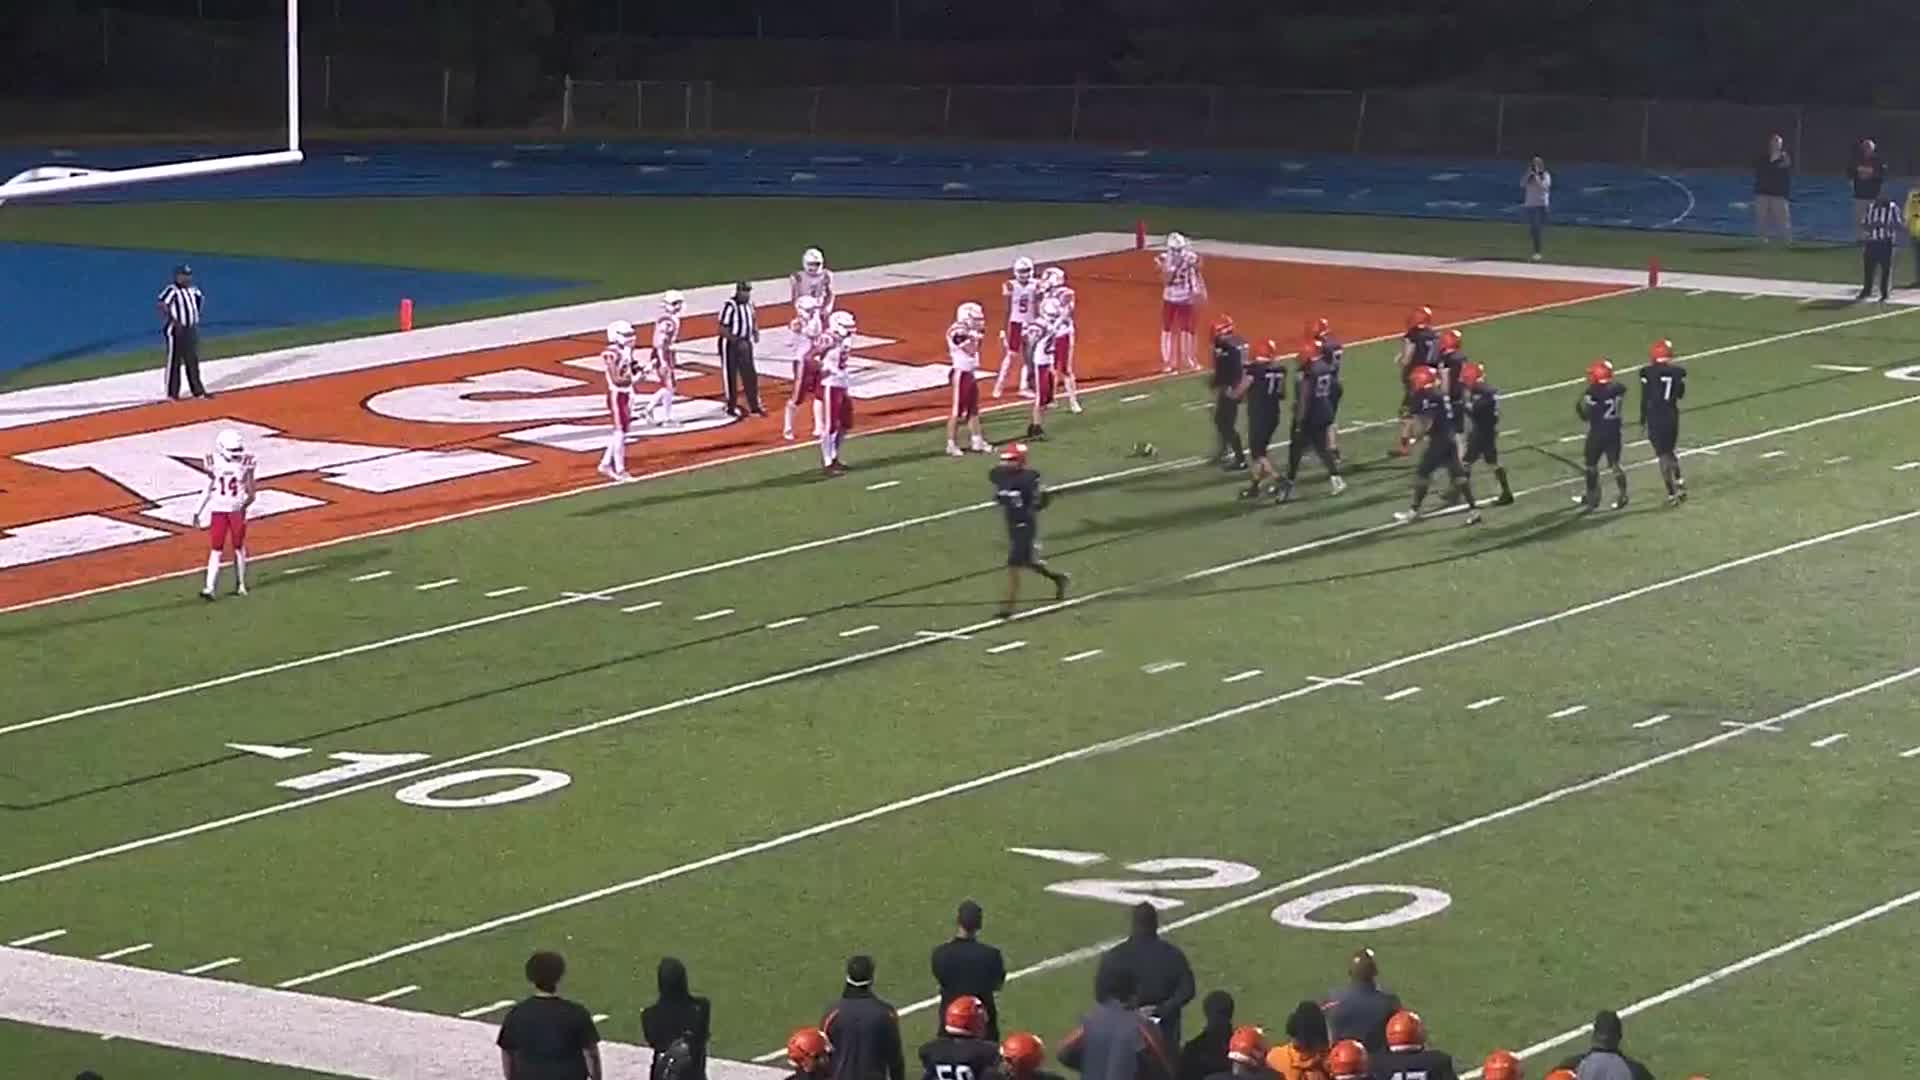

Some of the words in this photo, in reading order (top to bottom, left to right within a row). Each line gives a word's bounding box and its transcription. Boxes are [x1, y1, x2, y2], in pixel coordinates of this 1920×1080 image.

[1660, 376, 1673, 400] 7
[219, 476, 238, 497] 14
[275, 751, 573, 808] 10
[1042, 857, 1453, 931] 20
